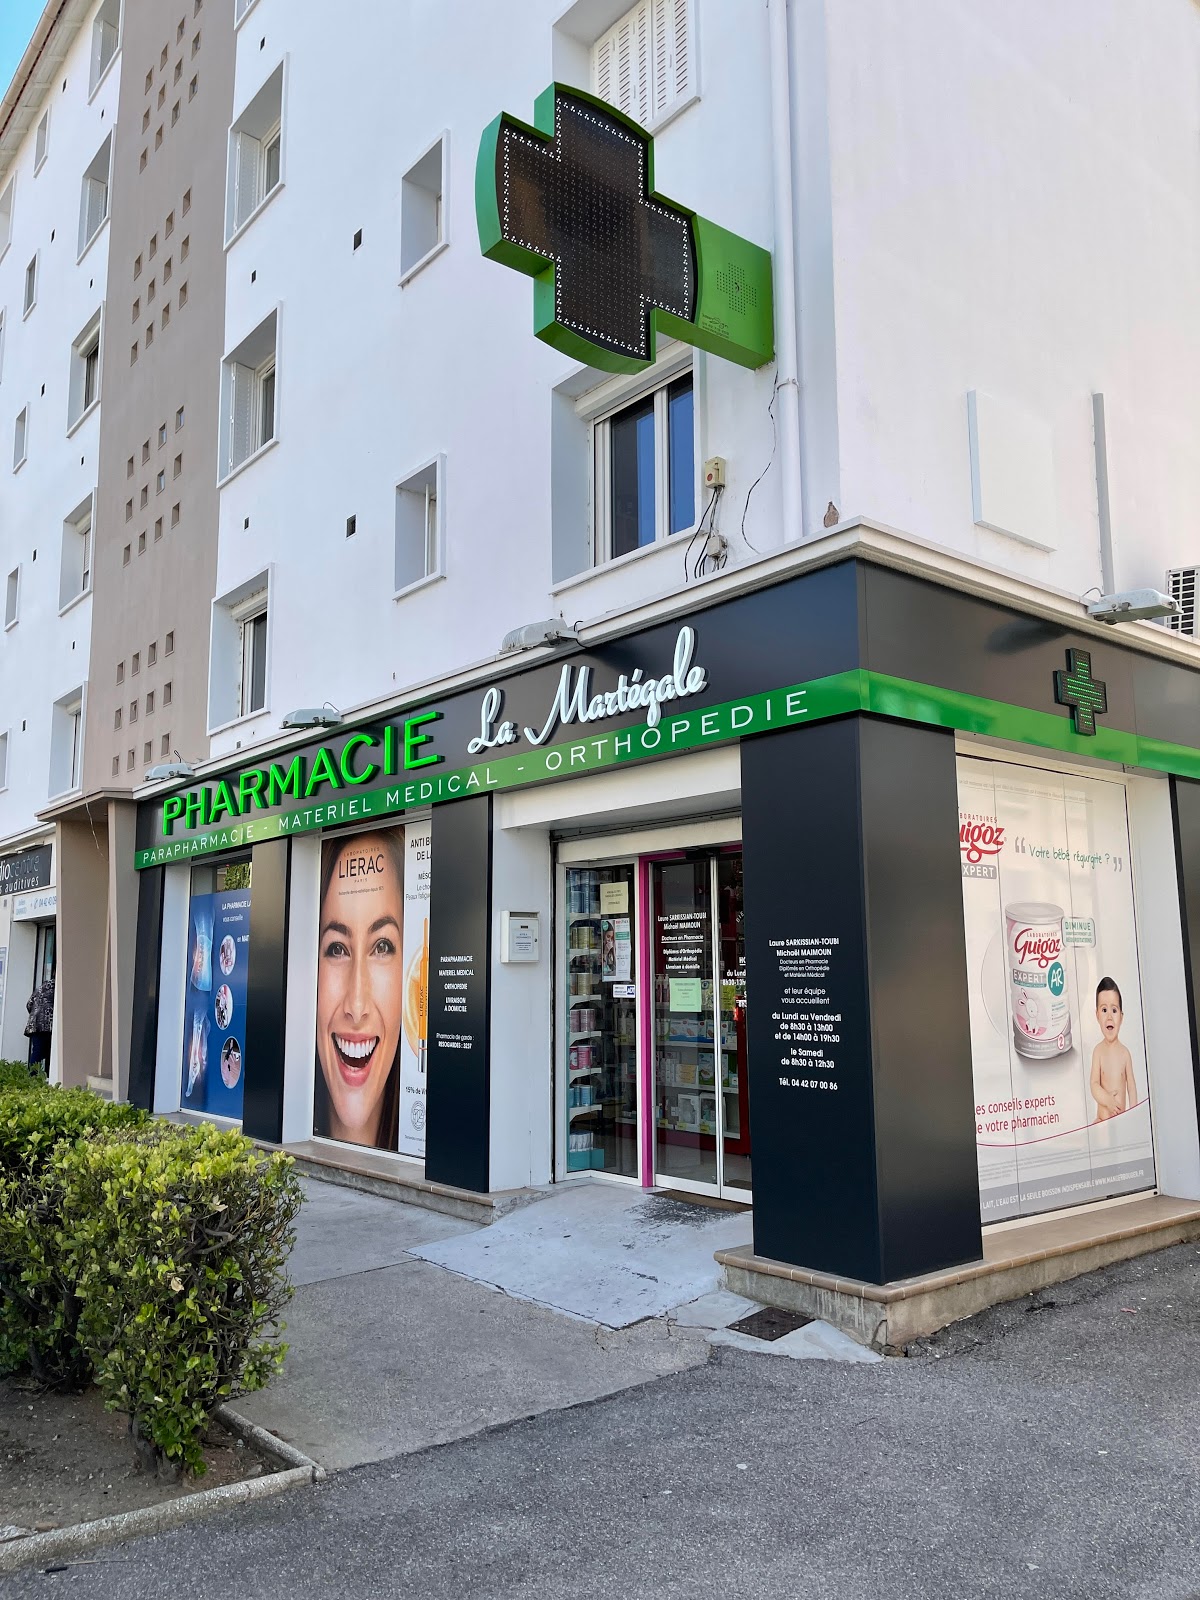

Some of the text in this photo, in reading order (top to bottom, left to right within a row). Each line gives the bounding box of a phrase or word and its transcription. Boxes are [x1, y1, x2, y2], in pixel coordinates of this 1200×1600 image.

[467, 626, 708, 754] La Martégale
[143, 825, 254, 864] PARAPHARMACIE
[278, 797, 372, 831] MATERIEL
[386, 767, 498, 807] MEDICAL
[545, 690, 808, 770] ORTHOPEDIE
[163, 711, 443, 835] PHARMACIE
[410, 838, 425, 848] ANTI
[416, 851, 425, 861] DE
[1028, 843, 1050, 859] Votre
[1052, 846, 1070, 861] bébé
[1073, 851, 1103, 869] régurgite
[338, 853, 384, 878] LIERAC
[5, 876, 39, 893] auditives
[1065, 921, 1091, 930] DIMINUE
[786, 938, 840, 946] SARKISSIAN-TOUBI
[1014, 927, 1061, 968] Guigoz
[440, 955, 473, 963] PARAPHARMACIE
[1013, 969, 1045, 984] EXPERT
[1051, 968, 1063, 989] AR
[784, 987, 826, 996] et leur équipe
[445, 996, 466, 1004] LIVRAISON
[796, 997, 830, 1005] accueillent
[771, 1012, 780, 1020] du
[781, 1012, 799, 1020] Lundi
[809, 1012, 842, 1021] Vendredi
[780, 1022, 834, 1032] de 8h30 à 13h00
[782, 1032, 791, 1040] de
[793, 1033, 812, 1041] 14h00
[813, 1033, 819, 1041] à
[820, 1034, 840, 1042] 19h30
[790, 1047, 824, 1057] le Samedi
[780, 1057, 835, 1069] de 8h30 à 12h30
[779, 1077, 838, 1090] Tél. 04 42 07 00 86
[974, 1095, 1056, 1115] es conseils experts
[985, 1119, 1009, 1133] votre
[1011, 1112, 1060, 1132] pharmacien
[996, 1197, 1009, 1207] L'EAU
[1009, 1195, 1019, 1204] EST
[1020, 1193, 1027, 1202] LA
[1026, 1190, 1042, 1200] SEULE
[1042, 1186, 1061, 1198] BOISSON
[1061, 1179, 1095, 1193] INDISPENSABLE
